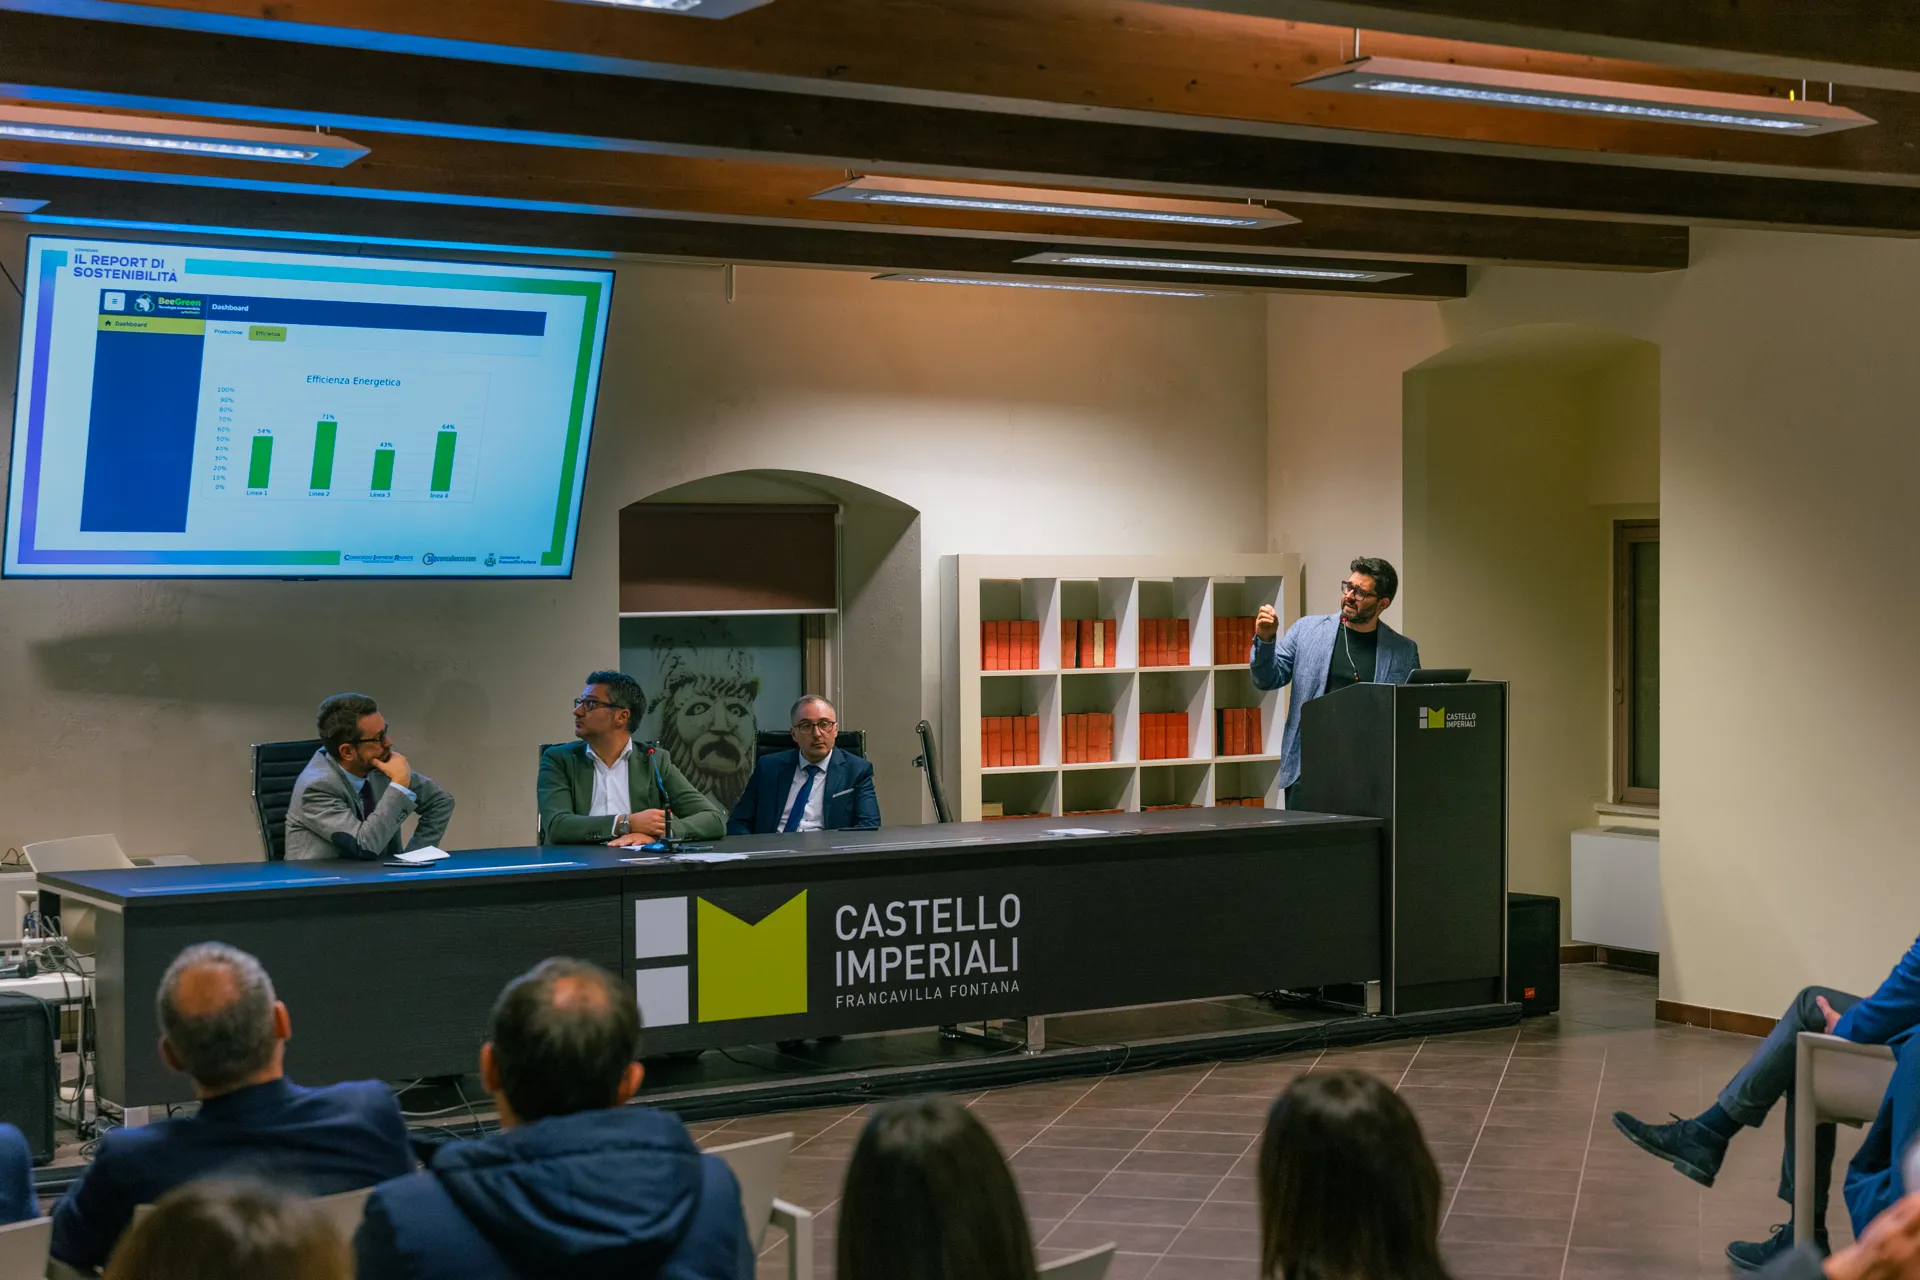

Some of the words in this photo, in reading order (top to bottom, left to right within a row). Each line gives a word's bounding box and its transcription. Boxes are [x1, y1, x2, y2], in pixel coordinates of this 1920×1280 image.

[74, 254, 87, 264] IL
[91, 255, 148, 268] REPORT
[151, 259, 165, 269] DI
[73, 267, 177, 282] SOSTENIBILITÀ
[158, 297, 201, 307] BeeGreen
[212, 303, 249, 312] Dashboard
[115, 320, 148, 328] Dashboard
[306, 375, 350, 385] Efficienza
[353, 377, 401, 387] Energetica
[1446, 712, 1477, 720] CASTELLO
[1446, 720, 1476, 728] IMPERIALI
[835, 893, 1021, 941] CASTELLO
[836, 937, 1019, 987] IMPERIALI
[836, 988, 943, 1009] FRANCAVILLA
[949, 979, 1020, 998] FONTANA
